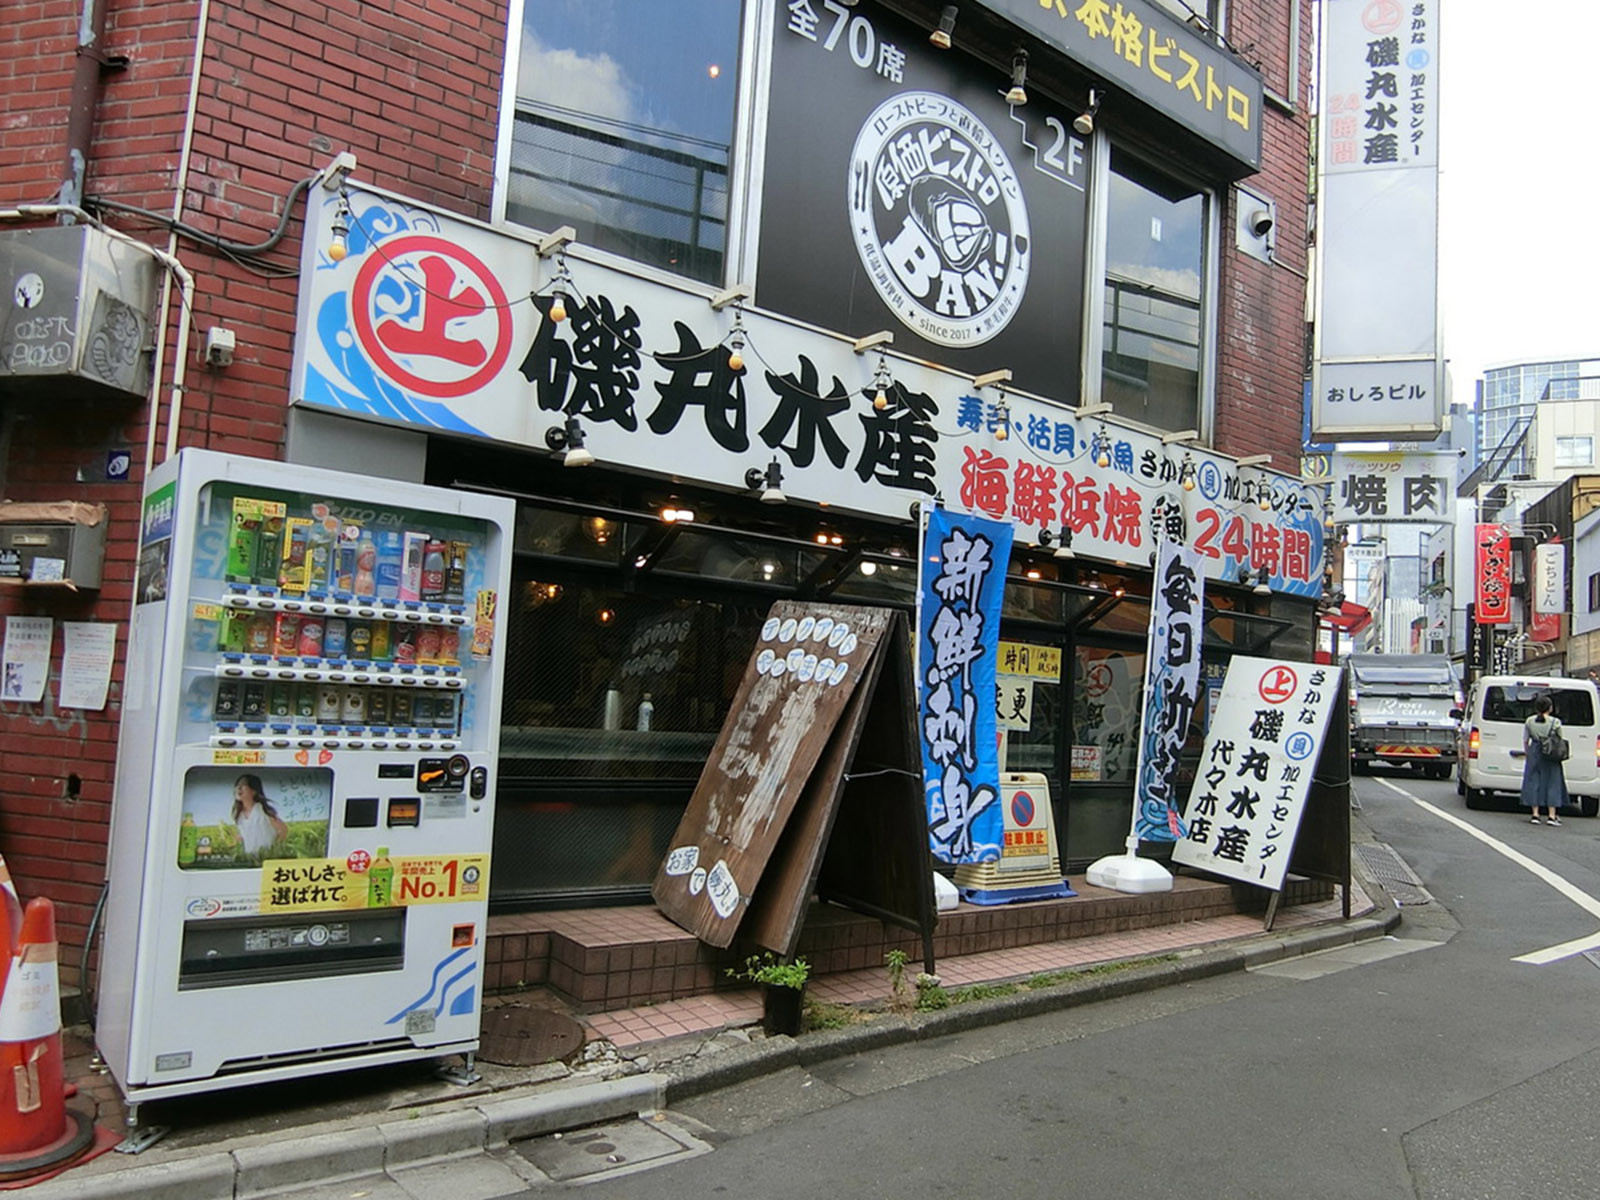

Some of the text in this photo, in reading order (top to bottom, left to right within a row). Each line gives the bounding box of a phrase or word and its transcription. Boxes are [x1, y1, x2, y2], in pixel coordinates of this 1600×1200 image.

[786, 0, 906, 84] 全70席
[1411, 4, 1426, 44] さかな
[1040, 0, 1250, 131] 、本格ビストロ
[1363, 36, 1400, 165] 磯丸水産
[1043, 116, 1085, 178] 2F
[1409, 73, 1426, 156] 加工センター
[875, 127, 1001, 211] 原価ビストロ
[882, 214, 1008, 317] BAN!
[920, 318, 972, 340] since 2017
[519, 291, 940, 496] 磯丸水産
[1327, 384, 1426, 403] おしろビル
[338, 506, 406, 526] ITO EN
[959, 445, 1144, 549] 海鮮浜焼
[1341, 474, 1448, 516] 焼肉
[1193, 508, 1311, 583] 24時間
[1298, 669, 1326, 725] さかな
[1186, 738, 1236, 845] 代々木店
[1213, 708, 1285, 864] 磯丸水産
[1257, 764, 1301, 880] 加工センター
[271, 885, 348, 906] 選ばれて。
[272, 864, 347, 884] おいしさで
[400, 859, 458, 900] No.1
